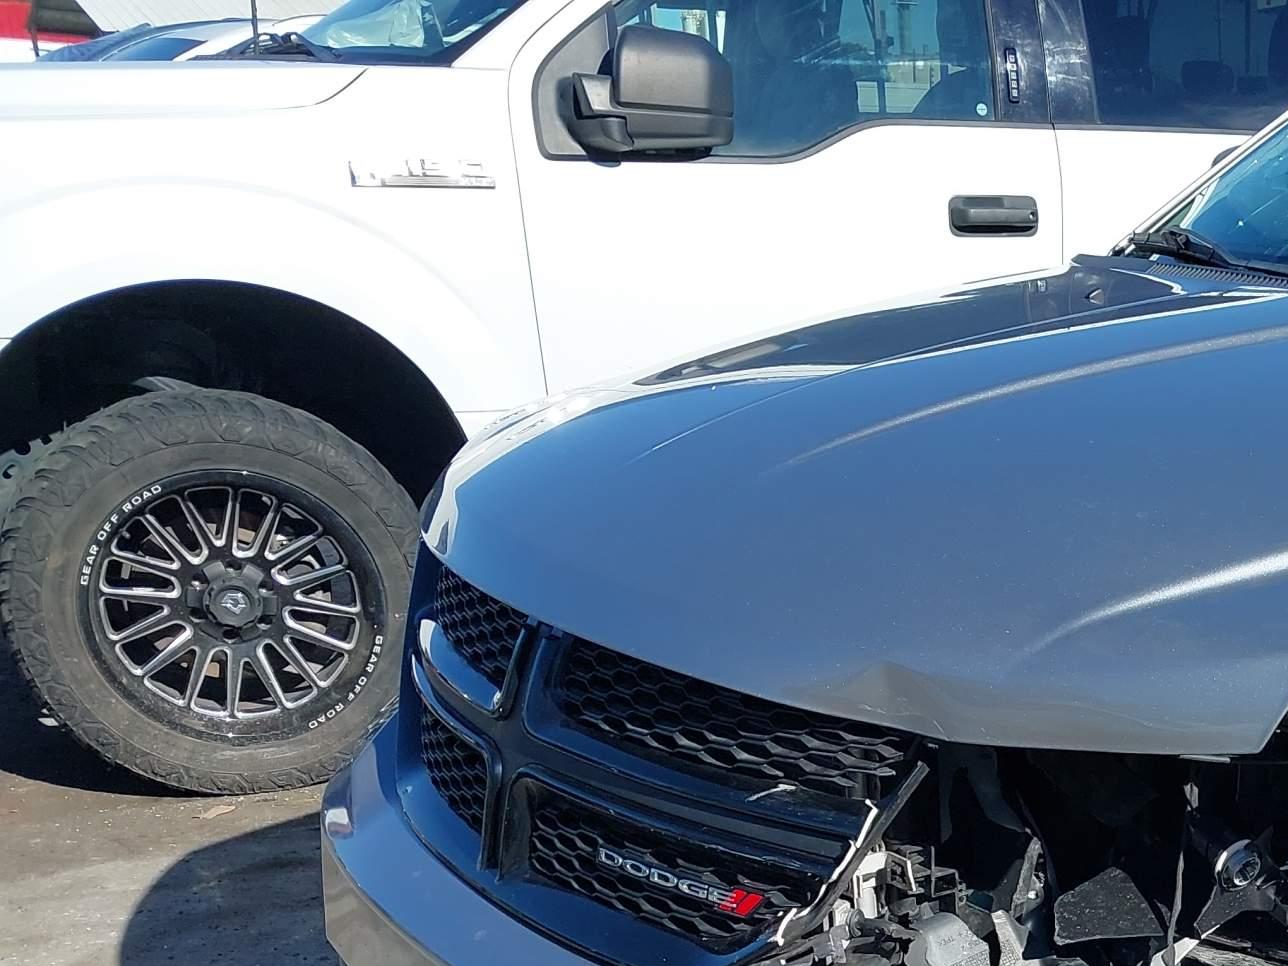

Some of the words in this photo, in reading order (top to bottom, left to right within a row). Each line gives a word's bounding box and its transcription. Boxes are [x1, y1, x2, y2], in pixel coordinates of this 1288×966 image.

[80, 545, 99, 586] GEAR
[97, 513, 119, 541] OFF
[122, 485, 162, 512] ROAD
[365, 635, 384, 673] GEAR
[347, 676, 368, 702] OFF
[308, 702, 345, 729] ROAD
[598, 848, 737, 909] DODGE
